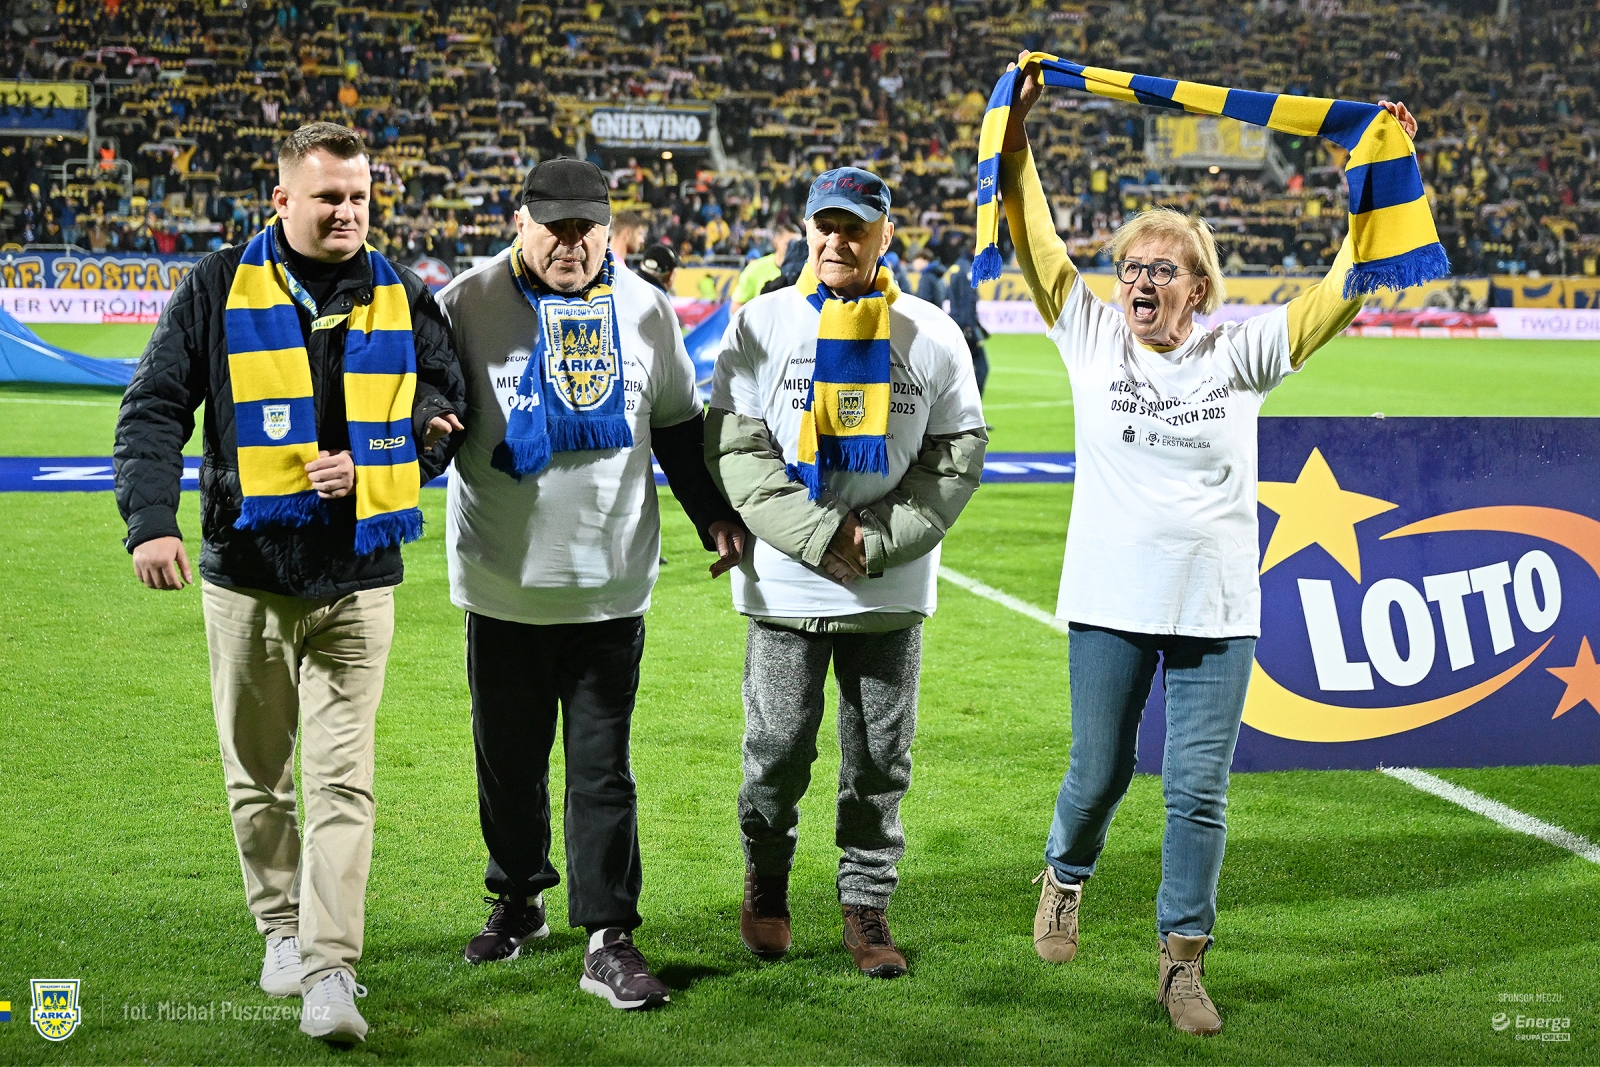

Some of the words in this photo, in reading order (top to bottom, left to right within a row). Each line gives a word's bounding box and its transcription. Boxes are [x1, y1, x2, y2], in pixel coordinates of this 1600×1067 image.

[591, 112, 702, 142] GNIEWINO
[50, 300, 71, 313] W
[558, 360, 606, 371] ARKA
[890, 402, 916, 415] 2025
[1111, 398, 1137, 413] OSÓB
[1202, 407, 1226, 420] 2025
[369, 436, 406, 450] 1929
[1162, 439, 1211, 449] EKSTRAKLASA
[1297, 549, 1562, 691] LOTTO
